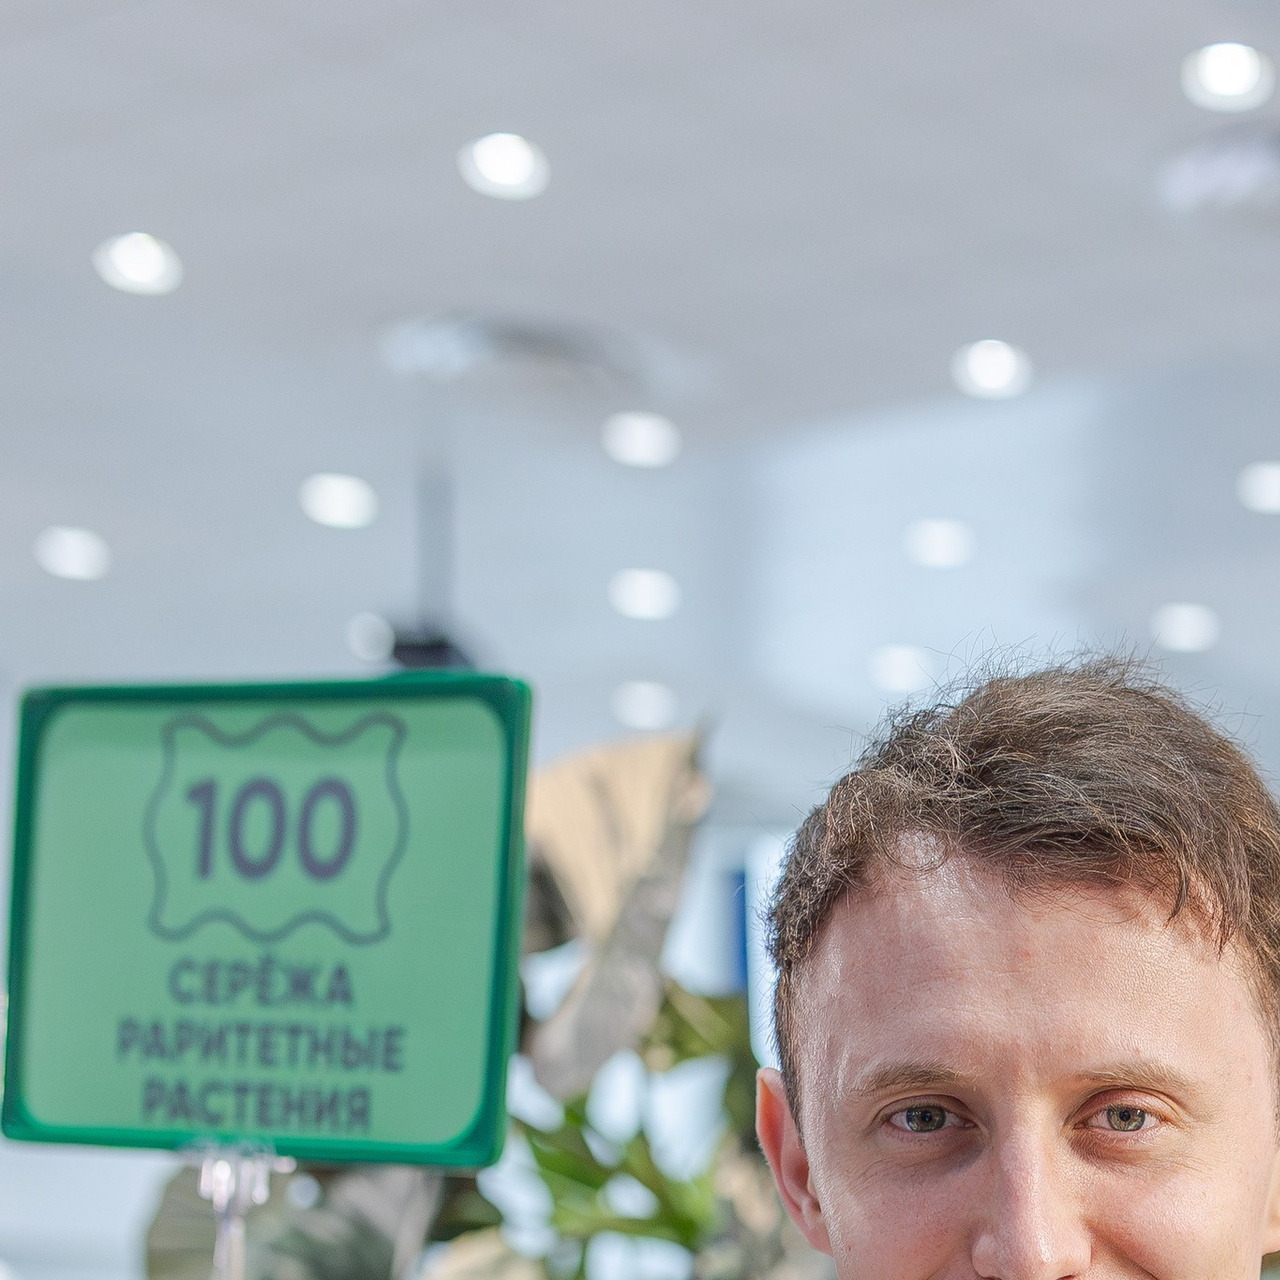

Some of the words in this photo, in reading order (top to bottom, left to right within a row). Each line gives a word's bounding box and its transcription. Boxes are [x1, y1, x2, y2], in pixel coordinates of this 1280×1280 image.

[184, 774, 358, 882] 100
[167, 954, 354, 1011] СЕРЁЖА
[116, 1016, 406, 1074] РАРИТЕТНЫЕ
[142, 1075, 372, 1133] РАСТЕНИЯ
